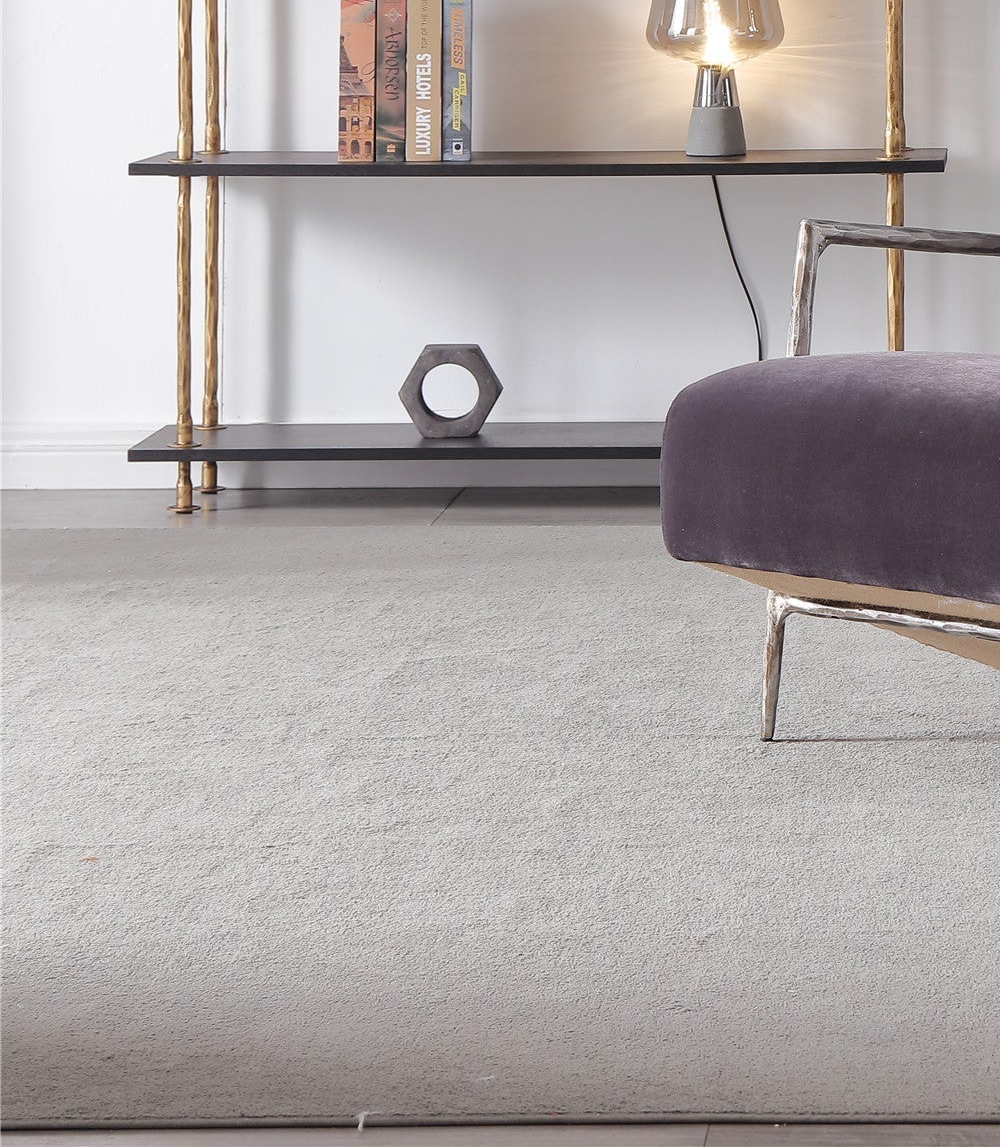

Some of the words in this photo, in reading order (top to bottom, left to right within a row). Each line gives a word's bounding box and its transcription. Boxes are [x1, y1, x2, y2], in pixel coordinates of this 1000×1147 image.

[421, 27, 428, 36] OF
[453, 12, 465, 66] TIMELESS
[415, 53, 432, 100] HOTELS
[415, 106, 432, 155] LUXURY
